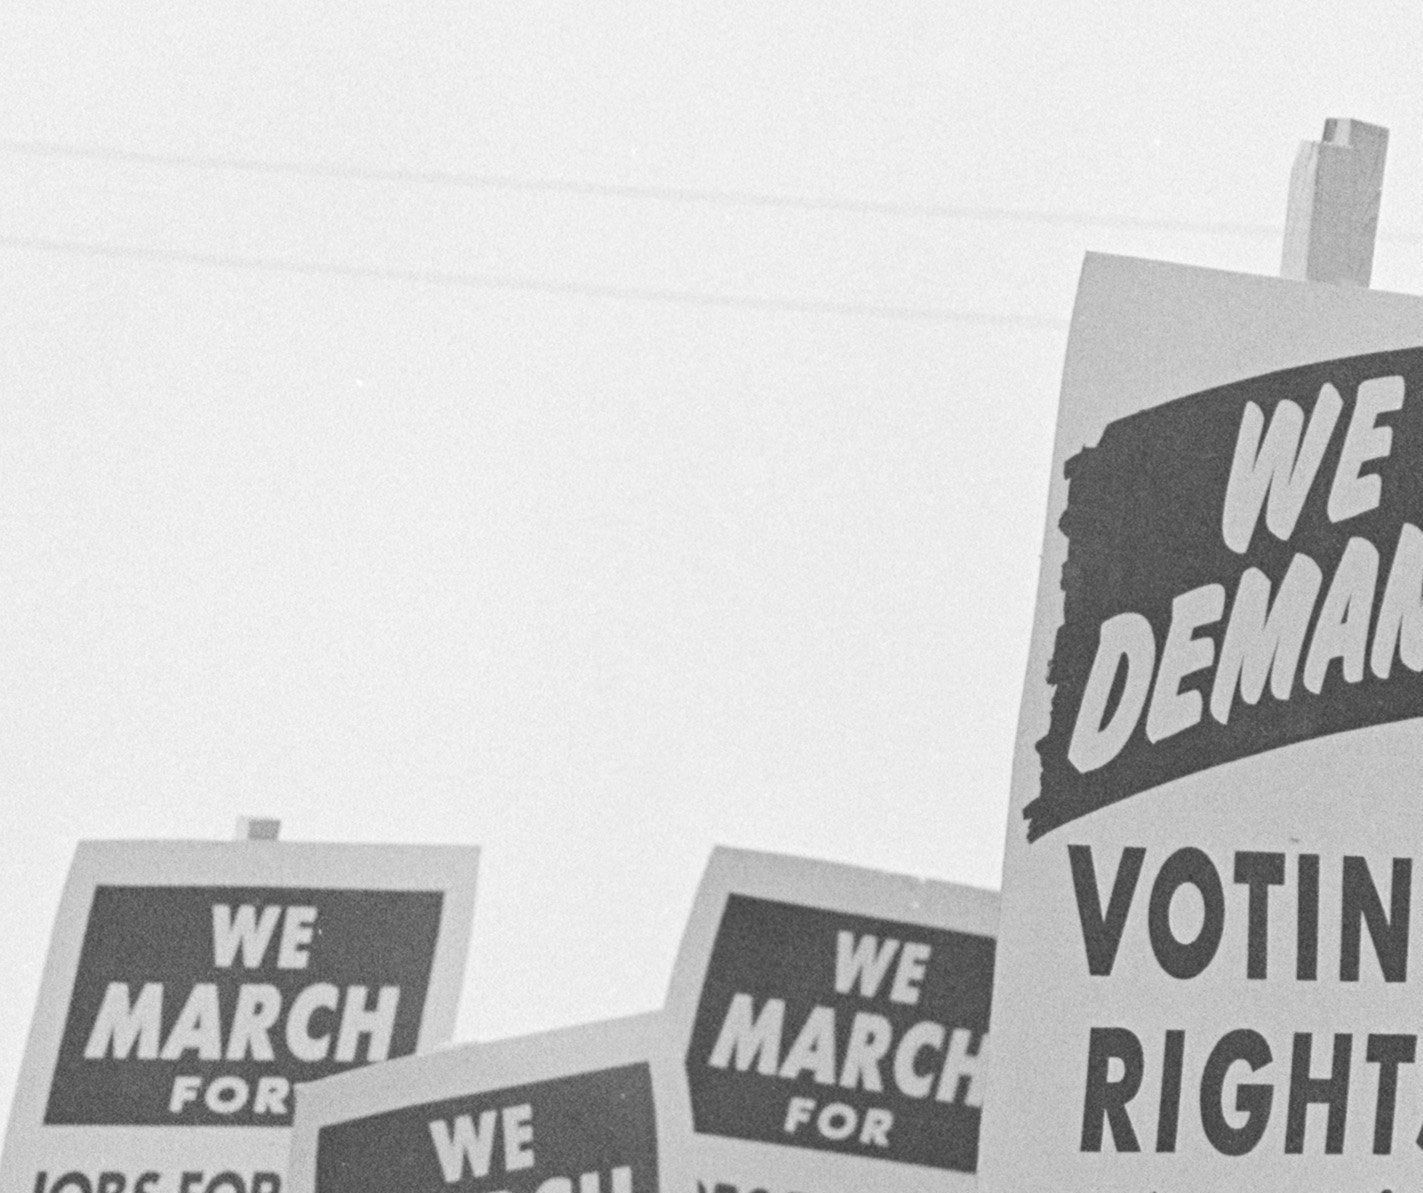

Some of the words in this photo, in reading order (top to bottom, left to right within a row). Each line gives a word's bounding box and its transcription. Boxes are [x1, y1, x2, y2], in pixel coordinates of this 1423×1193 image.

[1222, 375, 1406, 555] WE
[212, 904, 318, 968] WE
[834, 930, 931, 1004] WE
[84, 982, 400, 1062] MARCH
[708, 992, 990, 1108] MARCH
[169, 1076, 295, 1114] FOR
[783, 1097, 894, 1147] FOR
[429, 1104, 534, 1183] WE
